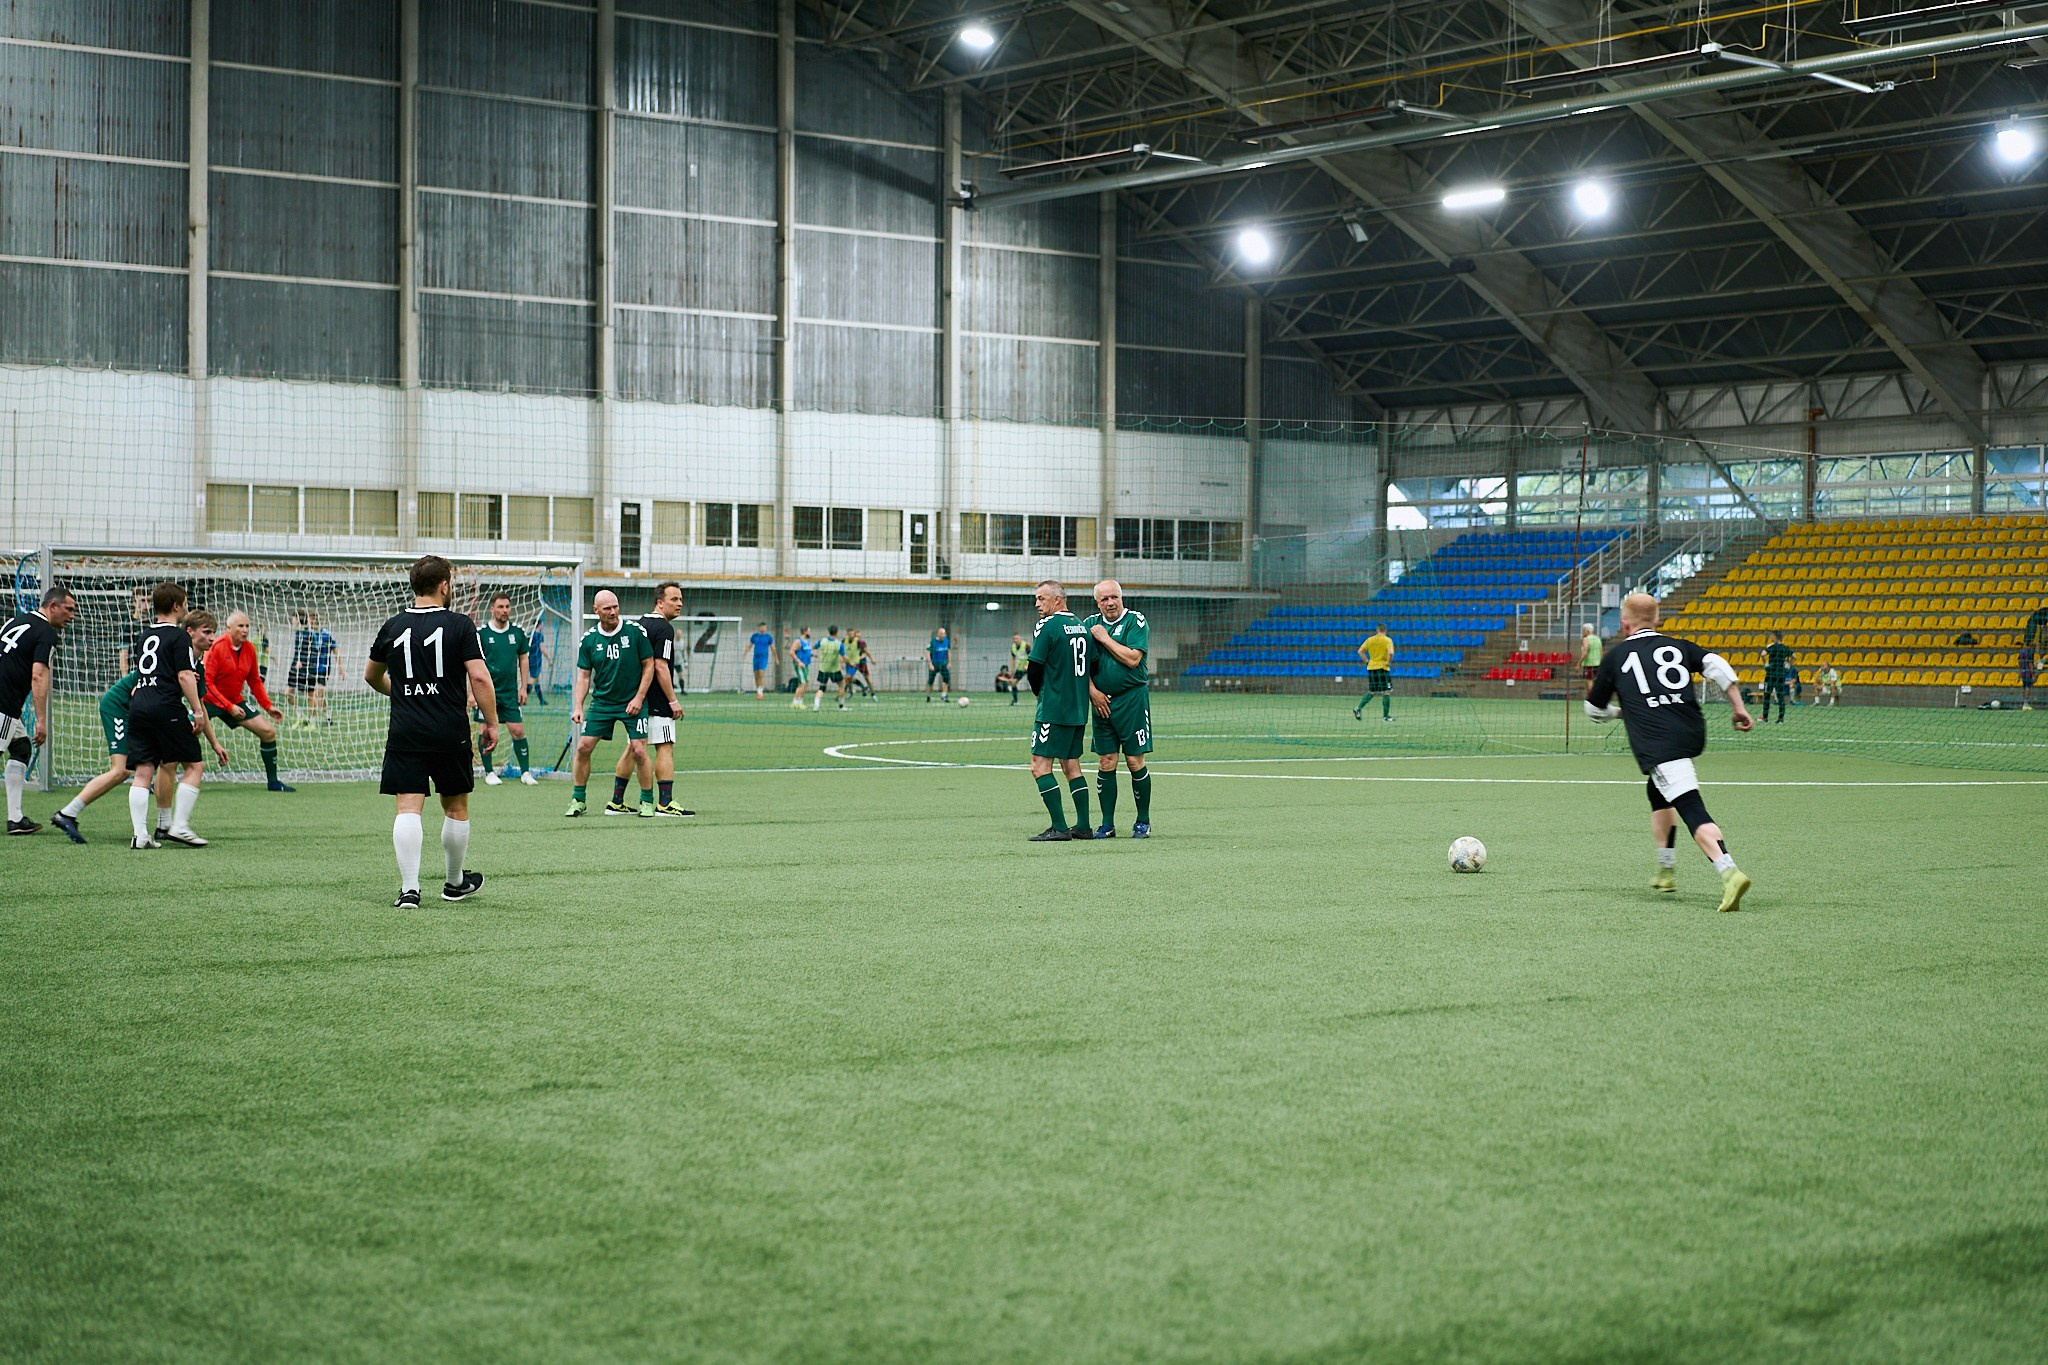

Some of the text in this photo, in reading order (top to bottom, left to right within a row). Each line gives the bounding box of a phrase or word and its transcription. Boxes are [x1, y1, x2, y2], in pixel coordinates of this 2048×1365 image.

[606, 643, 619, 660] 46
[693, 611, 718, 653] 2
[138, 635, 160, 675] 8
[393, 626, 444, 679] 11
[1069, 636, 1087, 677] 13
[1620, 645, 1690, 695] 18
[404, 682, 440, 696] БАЖ
[636, 718, 648, 734] 46
[1135, 729, 1146, 747] 13
